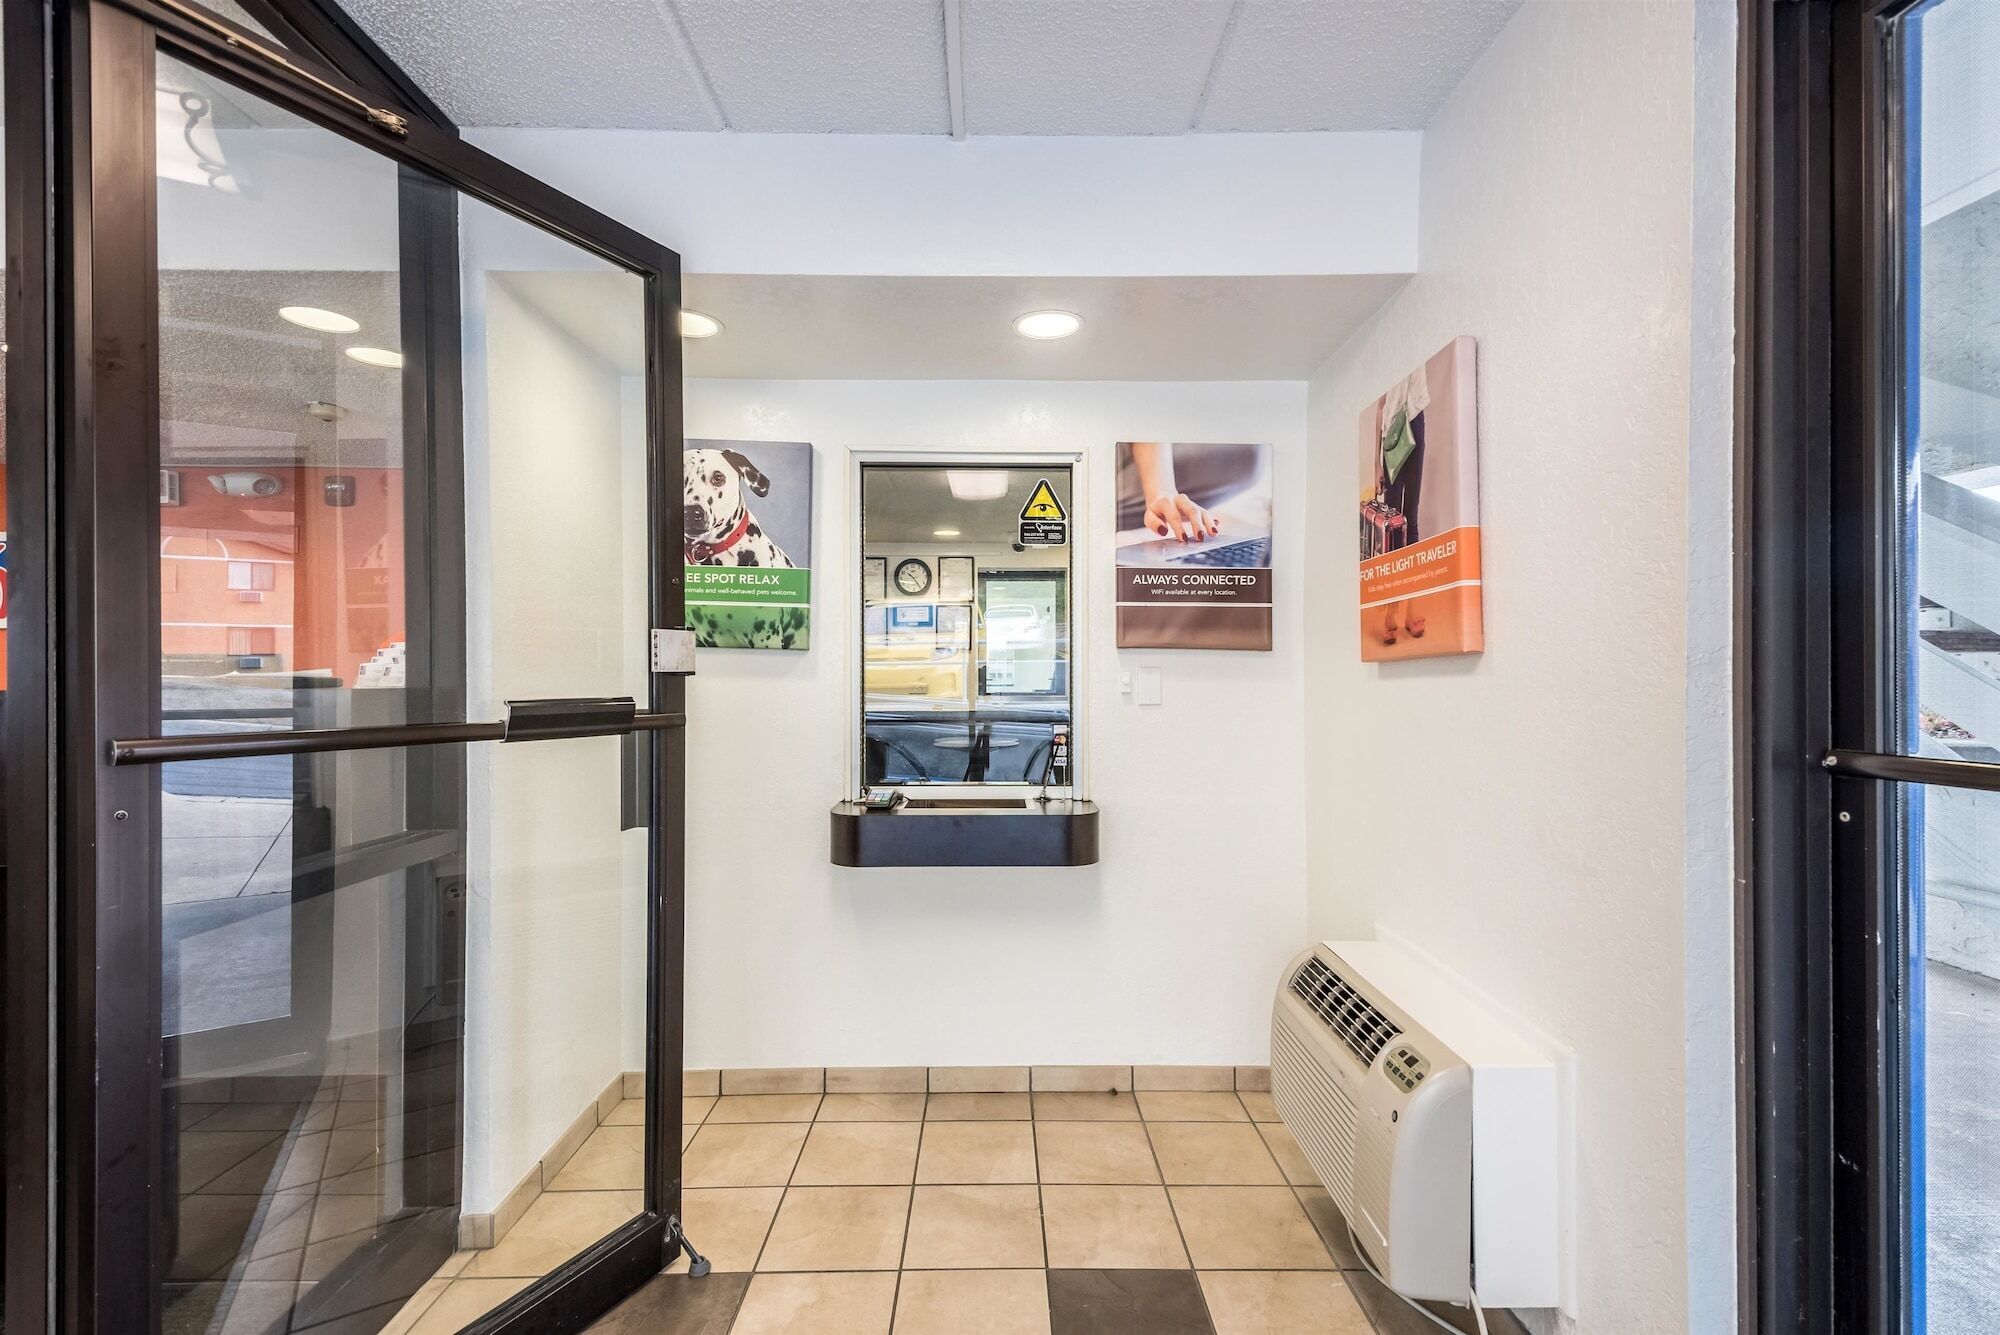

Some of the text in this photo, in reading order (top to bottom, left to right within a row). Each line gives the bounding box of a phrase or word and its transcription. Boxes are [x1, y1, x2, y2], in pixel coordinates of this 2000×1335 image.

[1360, 540, 1457, 581] FOR THE LIGHT TRAVELER
[686, 572, 780, 585] EE SPOT RELAX
[1132, 574, 1257, 586] ALWAYS CONNECTED
[717, 587, 756, 595] well-behaved
[756, 589, 770, 597] pets
[1213, 588, 1237, 596] location.
